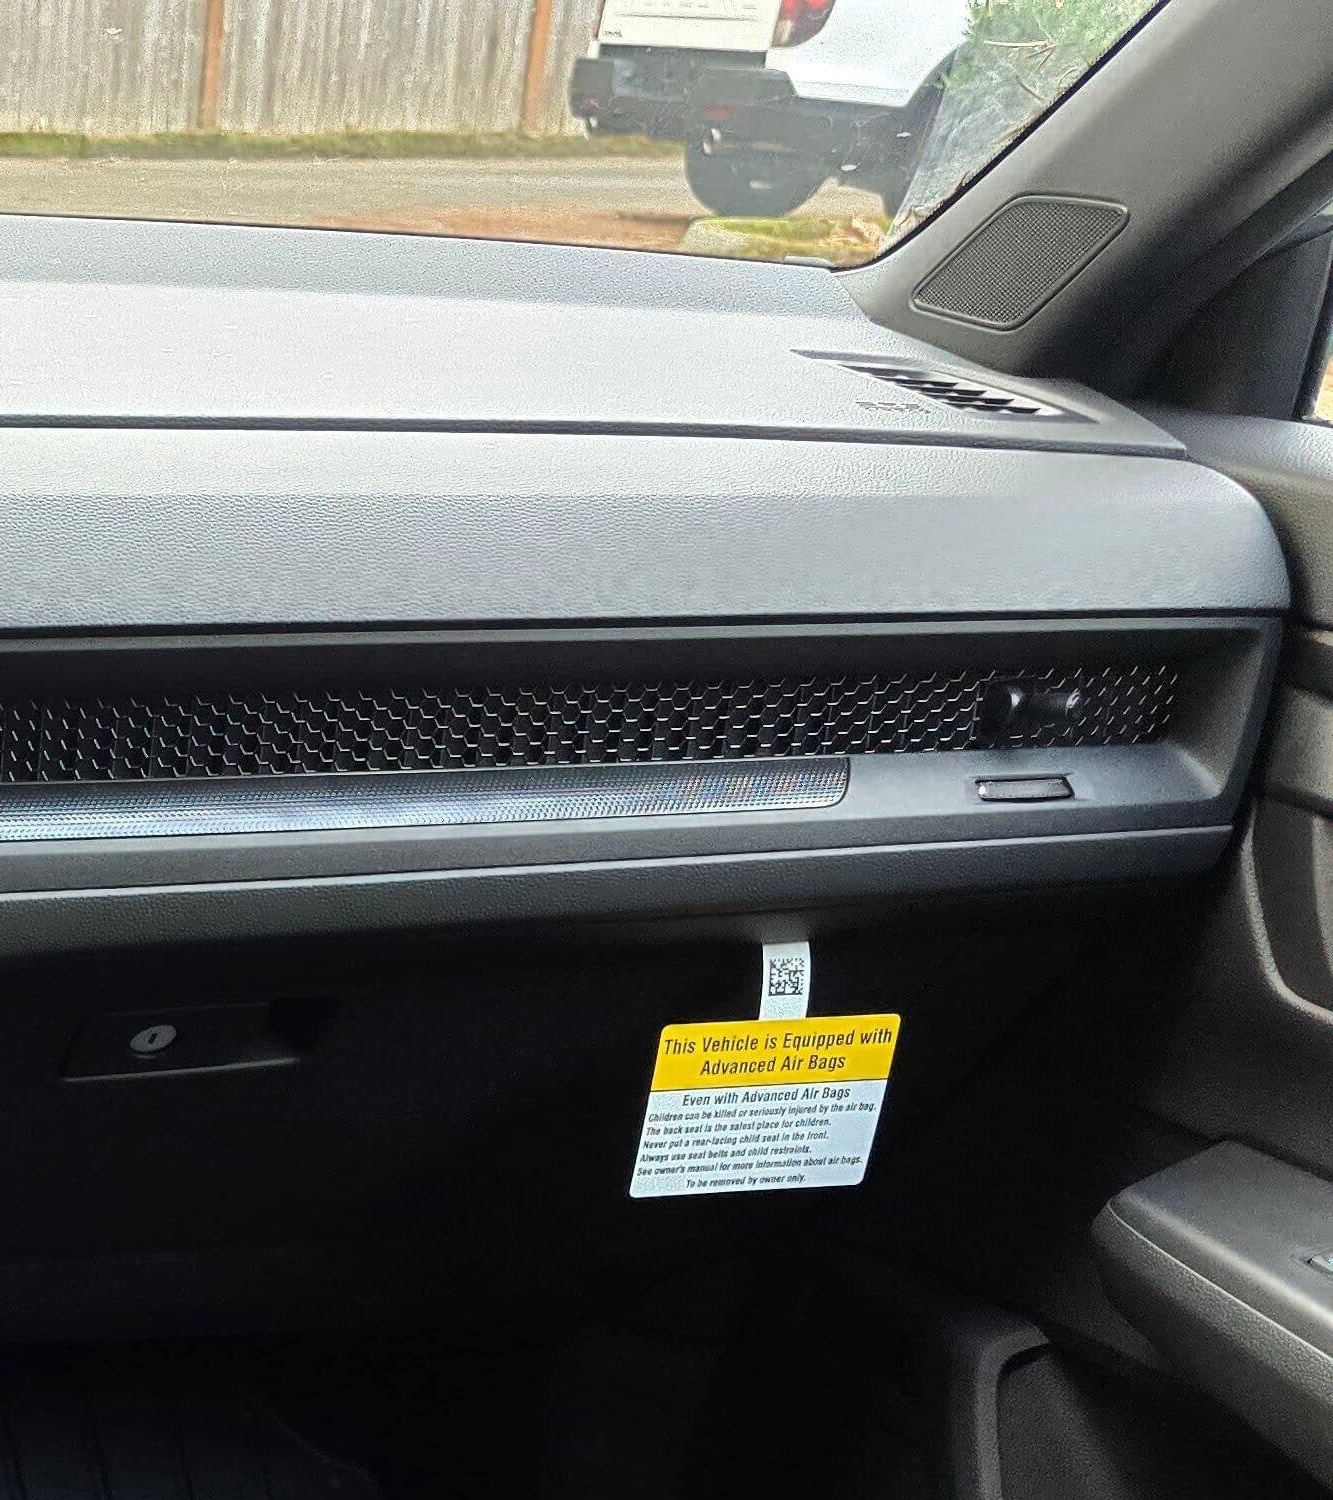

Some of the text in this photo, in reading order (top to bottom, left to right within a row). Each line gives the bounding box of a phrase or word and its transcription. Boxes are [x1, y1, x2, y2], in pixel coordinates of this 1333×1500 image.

[665, 1028, 893, 1055] This Vehicle is Equipped with
[700, 1054, 846, 1075] Advanced Air Bags
[682, 1086, 851, 1106] Even with Advanced Air Bags
[648, 1112, 683, 1122] Children
[685, 1112, 700, 1121] can
[701, 1111, 712, 1119] be
[714, 1109, 737, 1119] killed
[749, 1106, 787, 1116] seriously
[788, 1105, 818, 1116] injured
[819, 1104, 829, 1115] by
[830, 1103, 844, 1113] the
[845, 1103, 858, 1112] air
[859, 1102, 877, 1112] bag.
[646, 1126, 661, 1136] The
[663, 1126, 684, 1136] back
[684, 1124, 703, 1133] seat
[704, 1123, 712, 1133] is
[714, 1123, 728, 1132] the
[756, 1121, 779, 1131] place
[795, 1118, 831, 1128] children.
[643, 1140, 667, 1149] Never
[669, 1139, 683, 1150] put
[739, 1134, 761, 1144] child
[762, 1133, 780, 1143] seat
[781, 1132, 790, 1141] in
[791, 1131, 805, 1141] the
[640, 1153, 669, 1163] Always
[671, 1153, 686, 1161] use
[687, 1151, 706, 1160] seat
[708, 1150, 728, 1159] belts
[730, 1148, 746, 1158] and
[747, 1147, 769, 1157] child
[637, 1167, 652, 1176] See
[687, 1163, 718, 1173] manual
[732, 1161, 754, 1171] more
[755, 1158, 802, 1169] information
[803, 1157, 826, 1167] about
[686, 1173, 806, 1188] To be removed by owner only.
